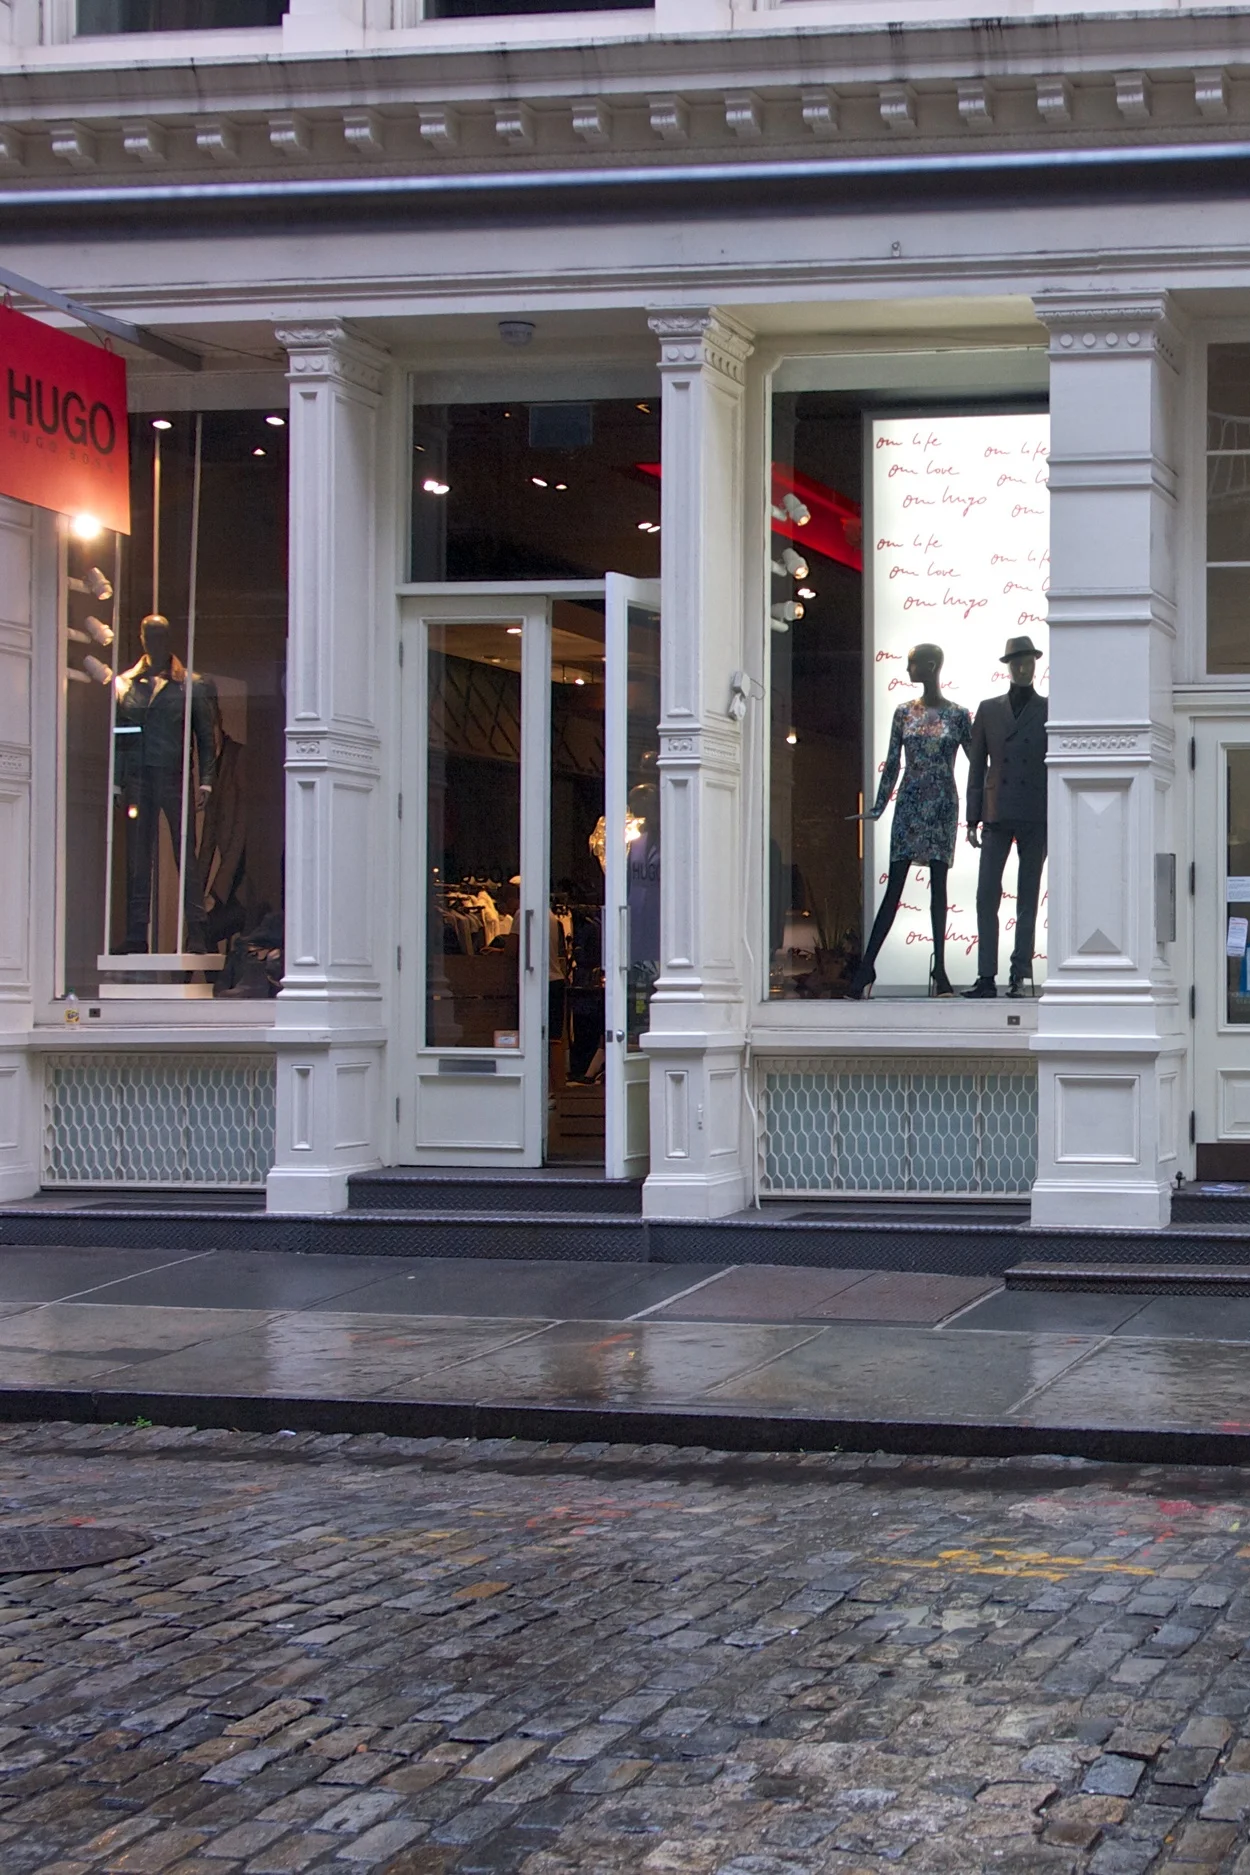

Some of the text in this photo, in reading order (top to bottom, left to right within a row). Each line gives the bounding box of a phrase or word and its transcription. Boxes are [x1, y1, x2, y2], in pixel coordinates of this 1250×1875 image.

[8, 368, 115, 455] HUGO
[9, 426, 57, 453] HUGO
[912, 432, 942, 453] life
[926, 460, 960, 475] love
[1035, 469, 1049, 484] lo
[942, 485, 988, 517] hugo
[913, 533, 943, 555] life
[927, 561, 961, 577] love
[943, 587, 989, 620] hugo
[944, 923, 979, 956] hug
